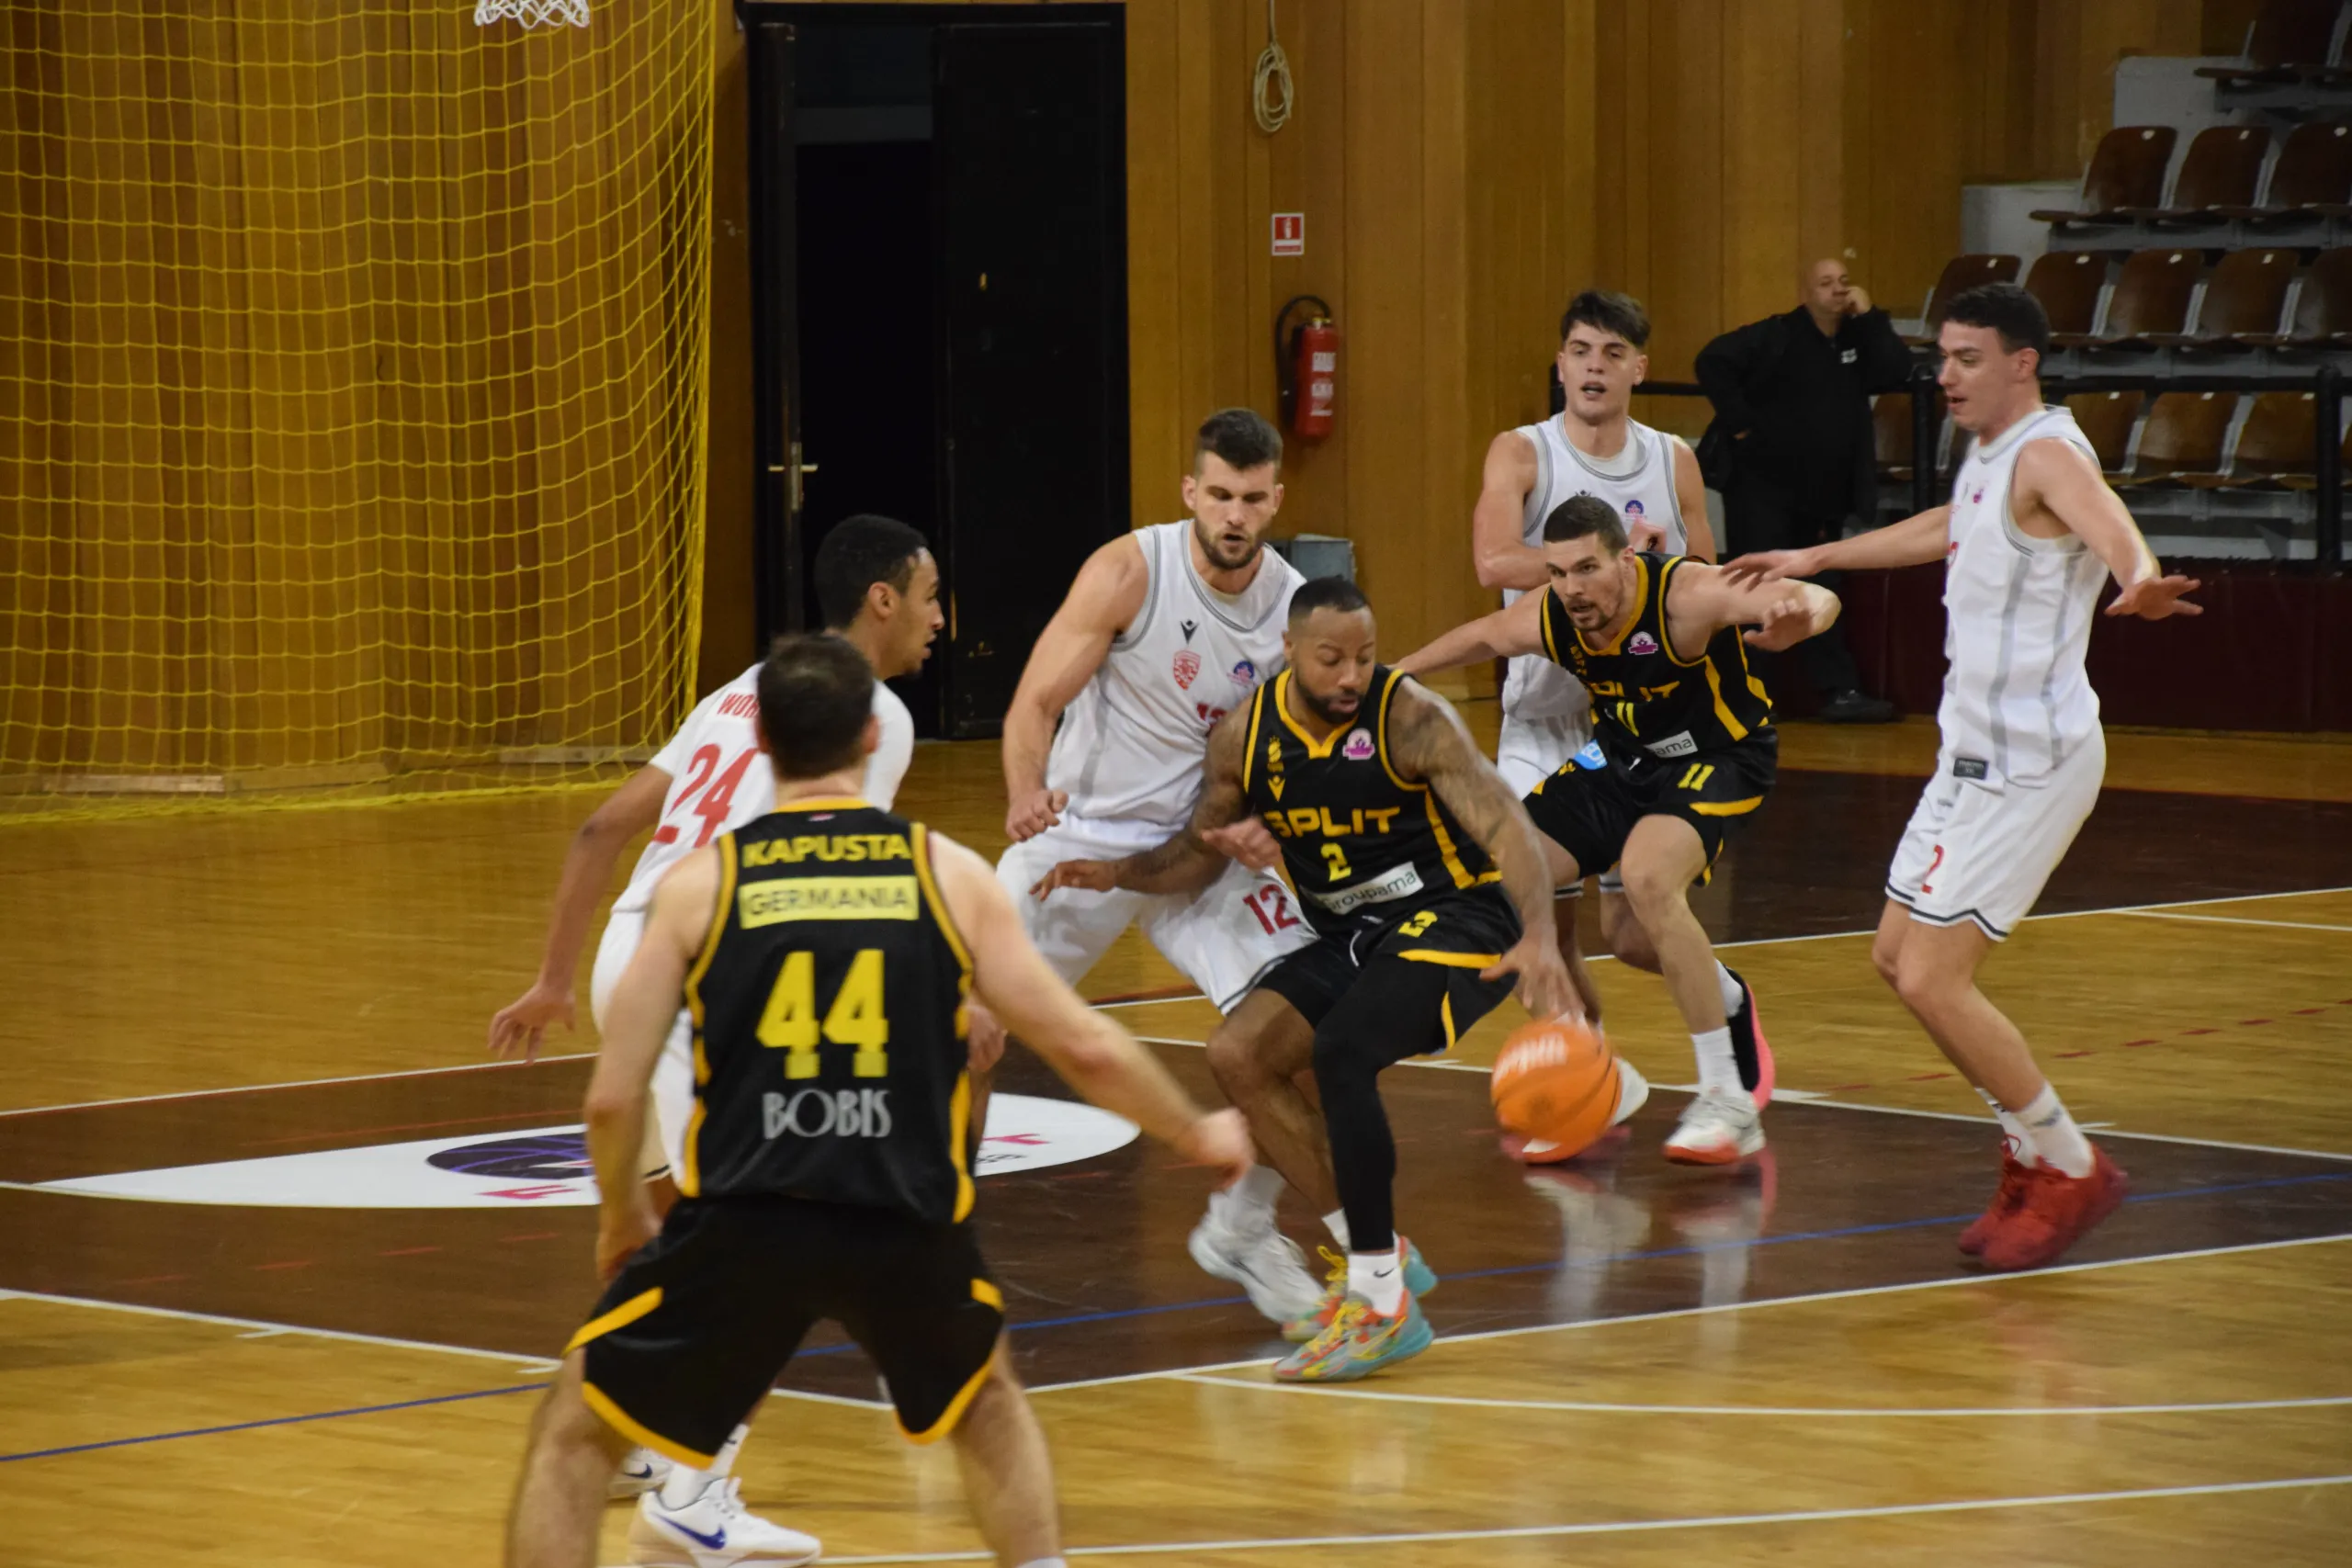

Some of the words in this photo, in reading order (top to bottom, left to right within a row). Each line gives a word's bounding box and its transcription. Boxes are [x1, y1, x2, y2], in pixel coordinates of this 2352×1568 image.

[652, 742, 761, 849] 24
[1677, 762, 1715, 792] 11
[1264, 806, 1401, 838] SPLIT
[741, 833, 912, 869] KAPUSTA
[1320, 842, 1352, 882] 2
[749, 886, 909, 917] GERMANIA
[1242, 883, 1301, 936] 12
[755, 948, 889, 1080] 44
[762, 1089, 893, 1140] BOBIS
